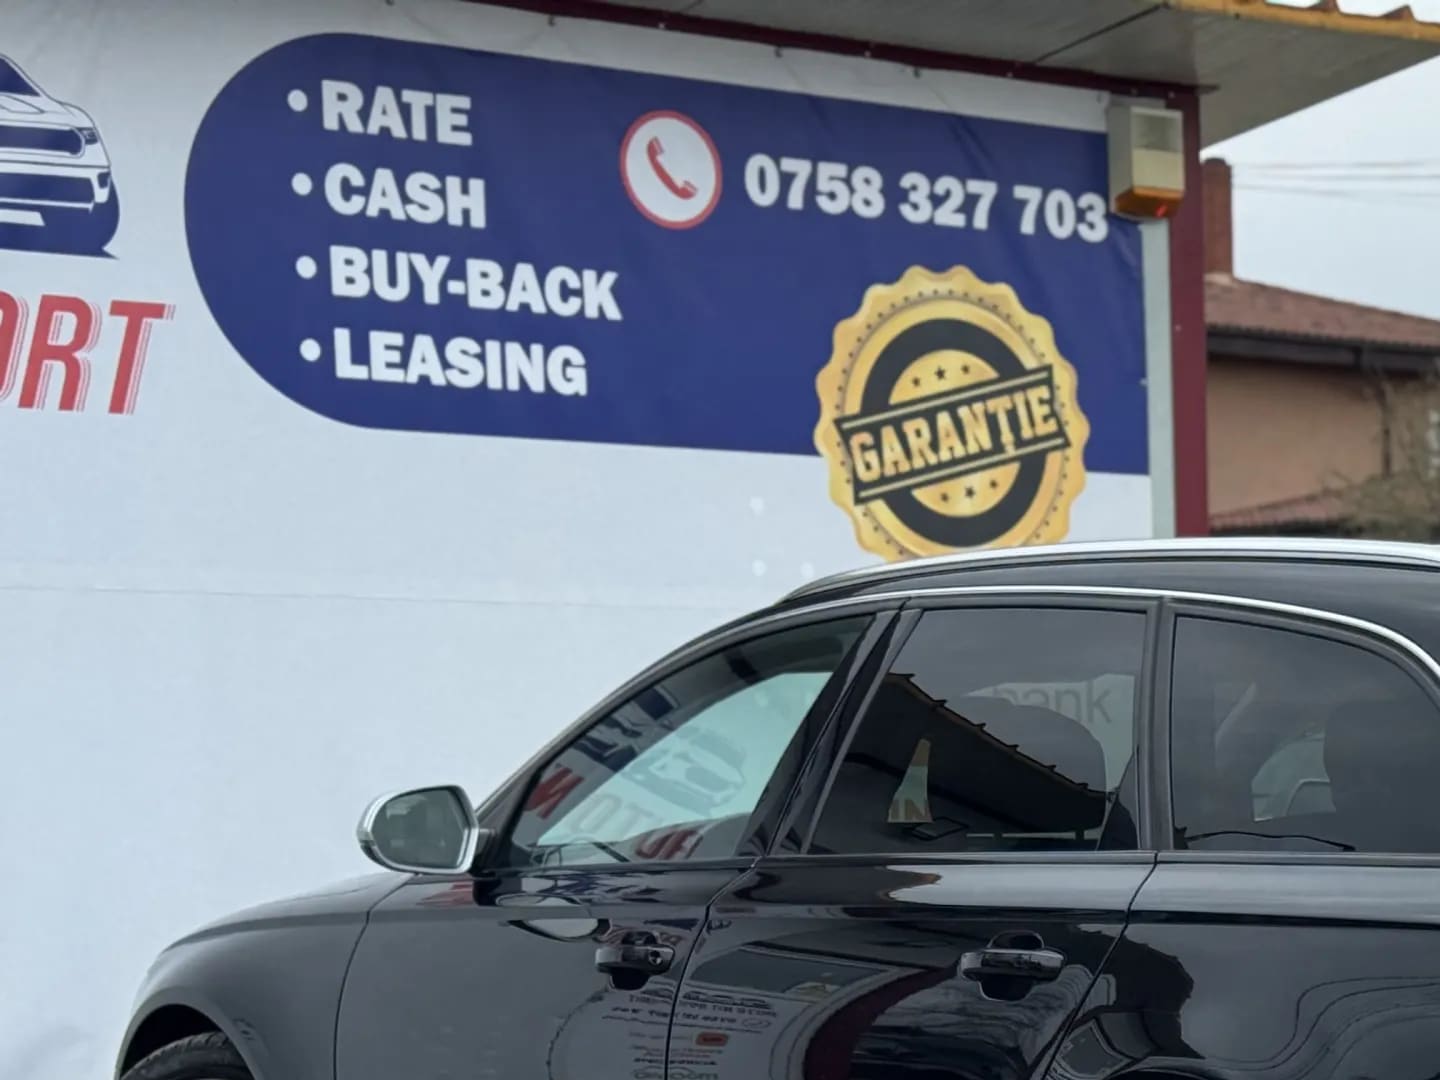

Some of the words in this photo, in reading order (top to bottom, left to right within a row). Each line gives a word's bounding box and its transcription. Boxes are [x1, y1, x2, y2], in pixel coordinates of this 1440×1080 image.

[320, 79, 472, 146] RATE
[324, 162, 486, 229] CASH
[745, 153, 885, 218] 0758
[899, 172, 997, 231] 327
[1013, 185, 1108, 242] 703
[329, 245, 622, 321] BUY-BACK
[333, 328, 588, 396] LEASING
